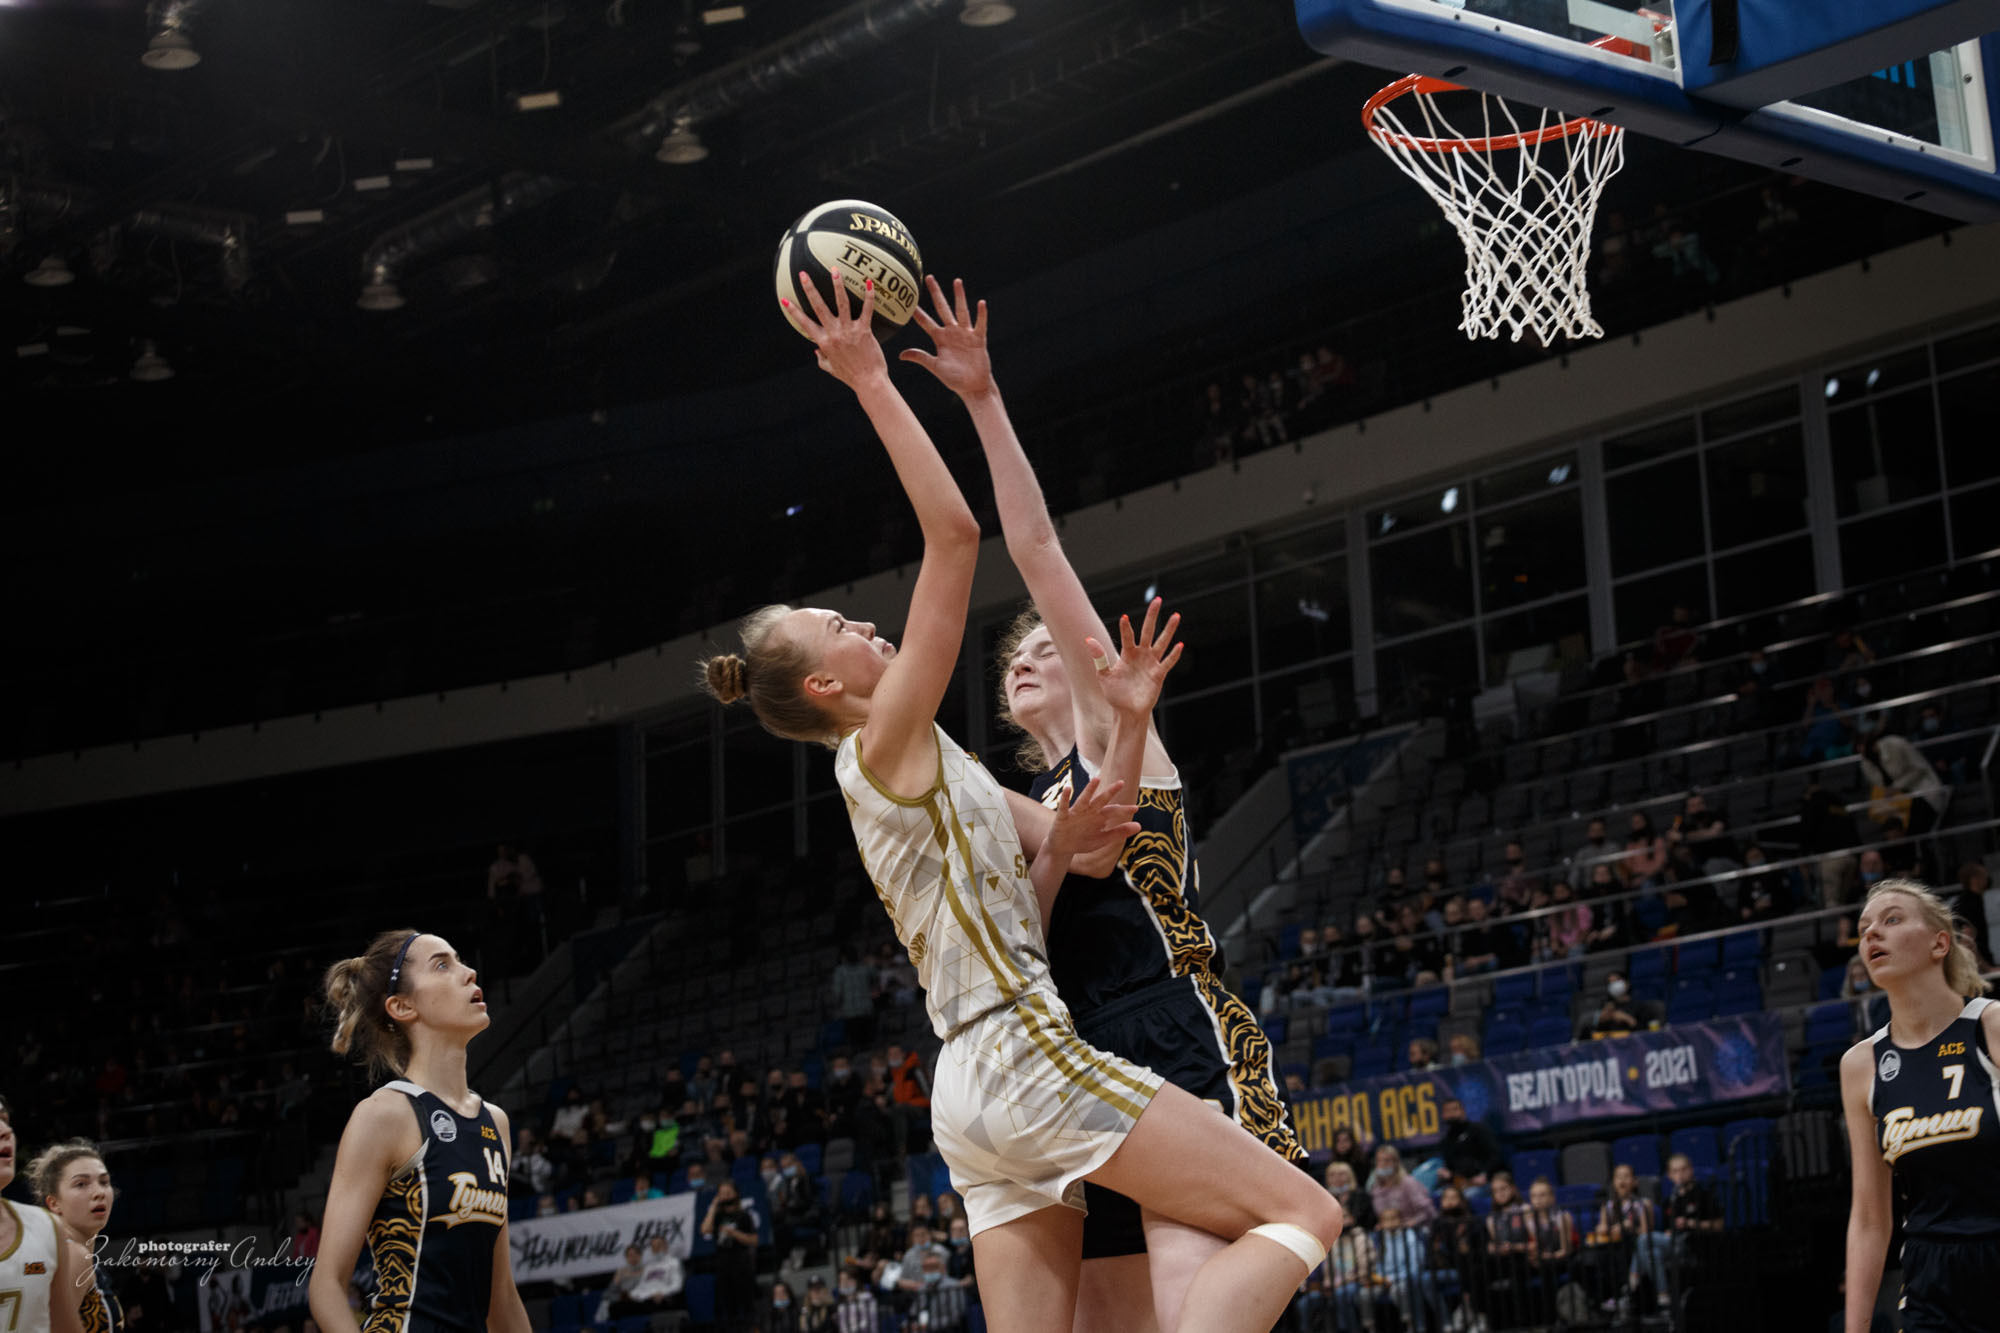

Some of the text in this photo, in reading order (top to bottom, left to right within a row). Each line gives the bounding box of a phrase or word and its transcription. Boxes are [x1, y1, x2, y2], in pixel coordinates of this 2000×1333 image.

[842, 244, 915, 309] TF-1000
[1506, 1044, 1699, 1112] БЕЛГОРОД 2021
[1942, 1063, 1965, 1100] 7
[1293, 1081, 1441, 1151] ИНАЛ АСБ
[483, 1147, 506, 1187] 14
